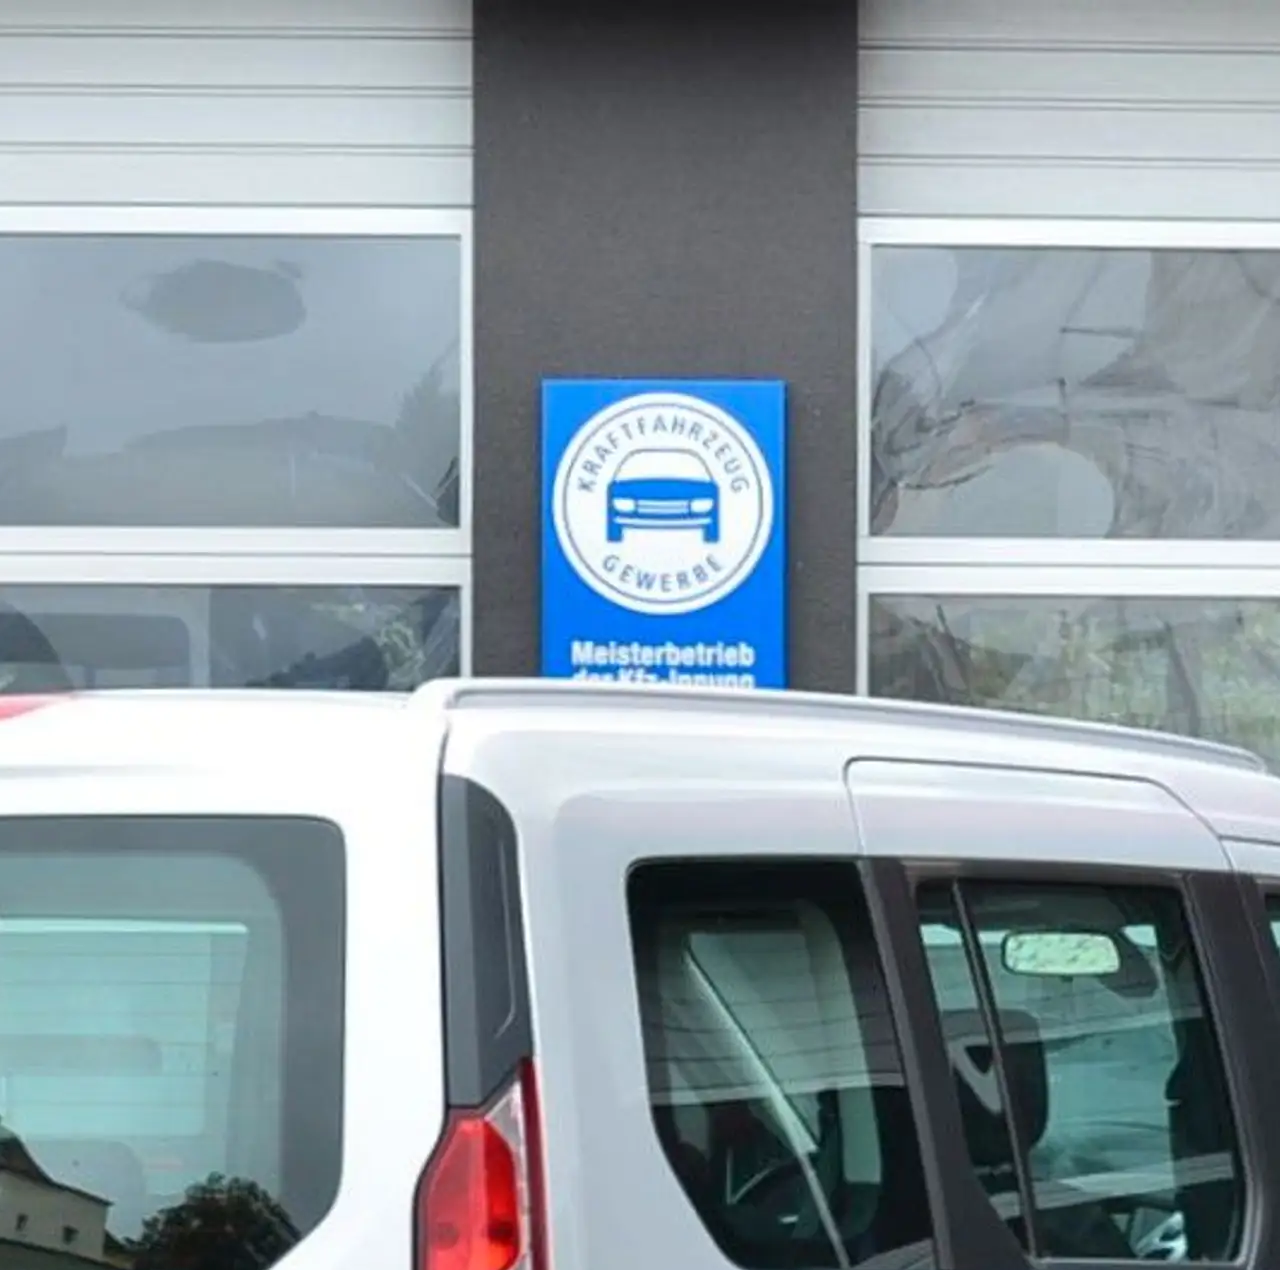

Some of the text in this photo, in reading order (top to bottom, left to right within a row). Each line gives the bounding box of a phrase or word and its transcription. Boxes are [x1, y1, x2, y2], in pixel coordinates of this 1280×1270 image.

[576, 414, 750, 493] KRAFTFAHRZEUG
[603, 554, 724, 592] GEWERBE
[572, 641, 756, 667] Meisterbetrieb
